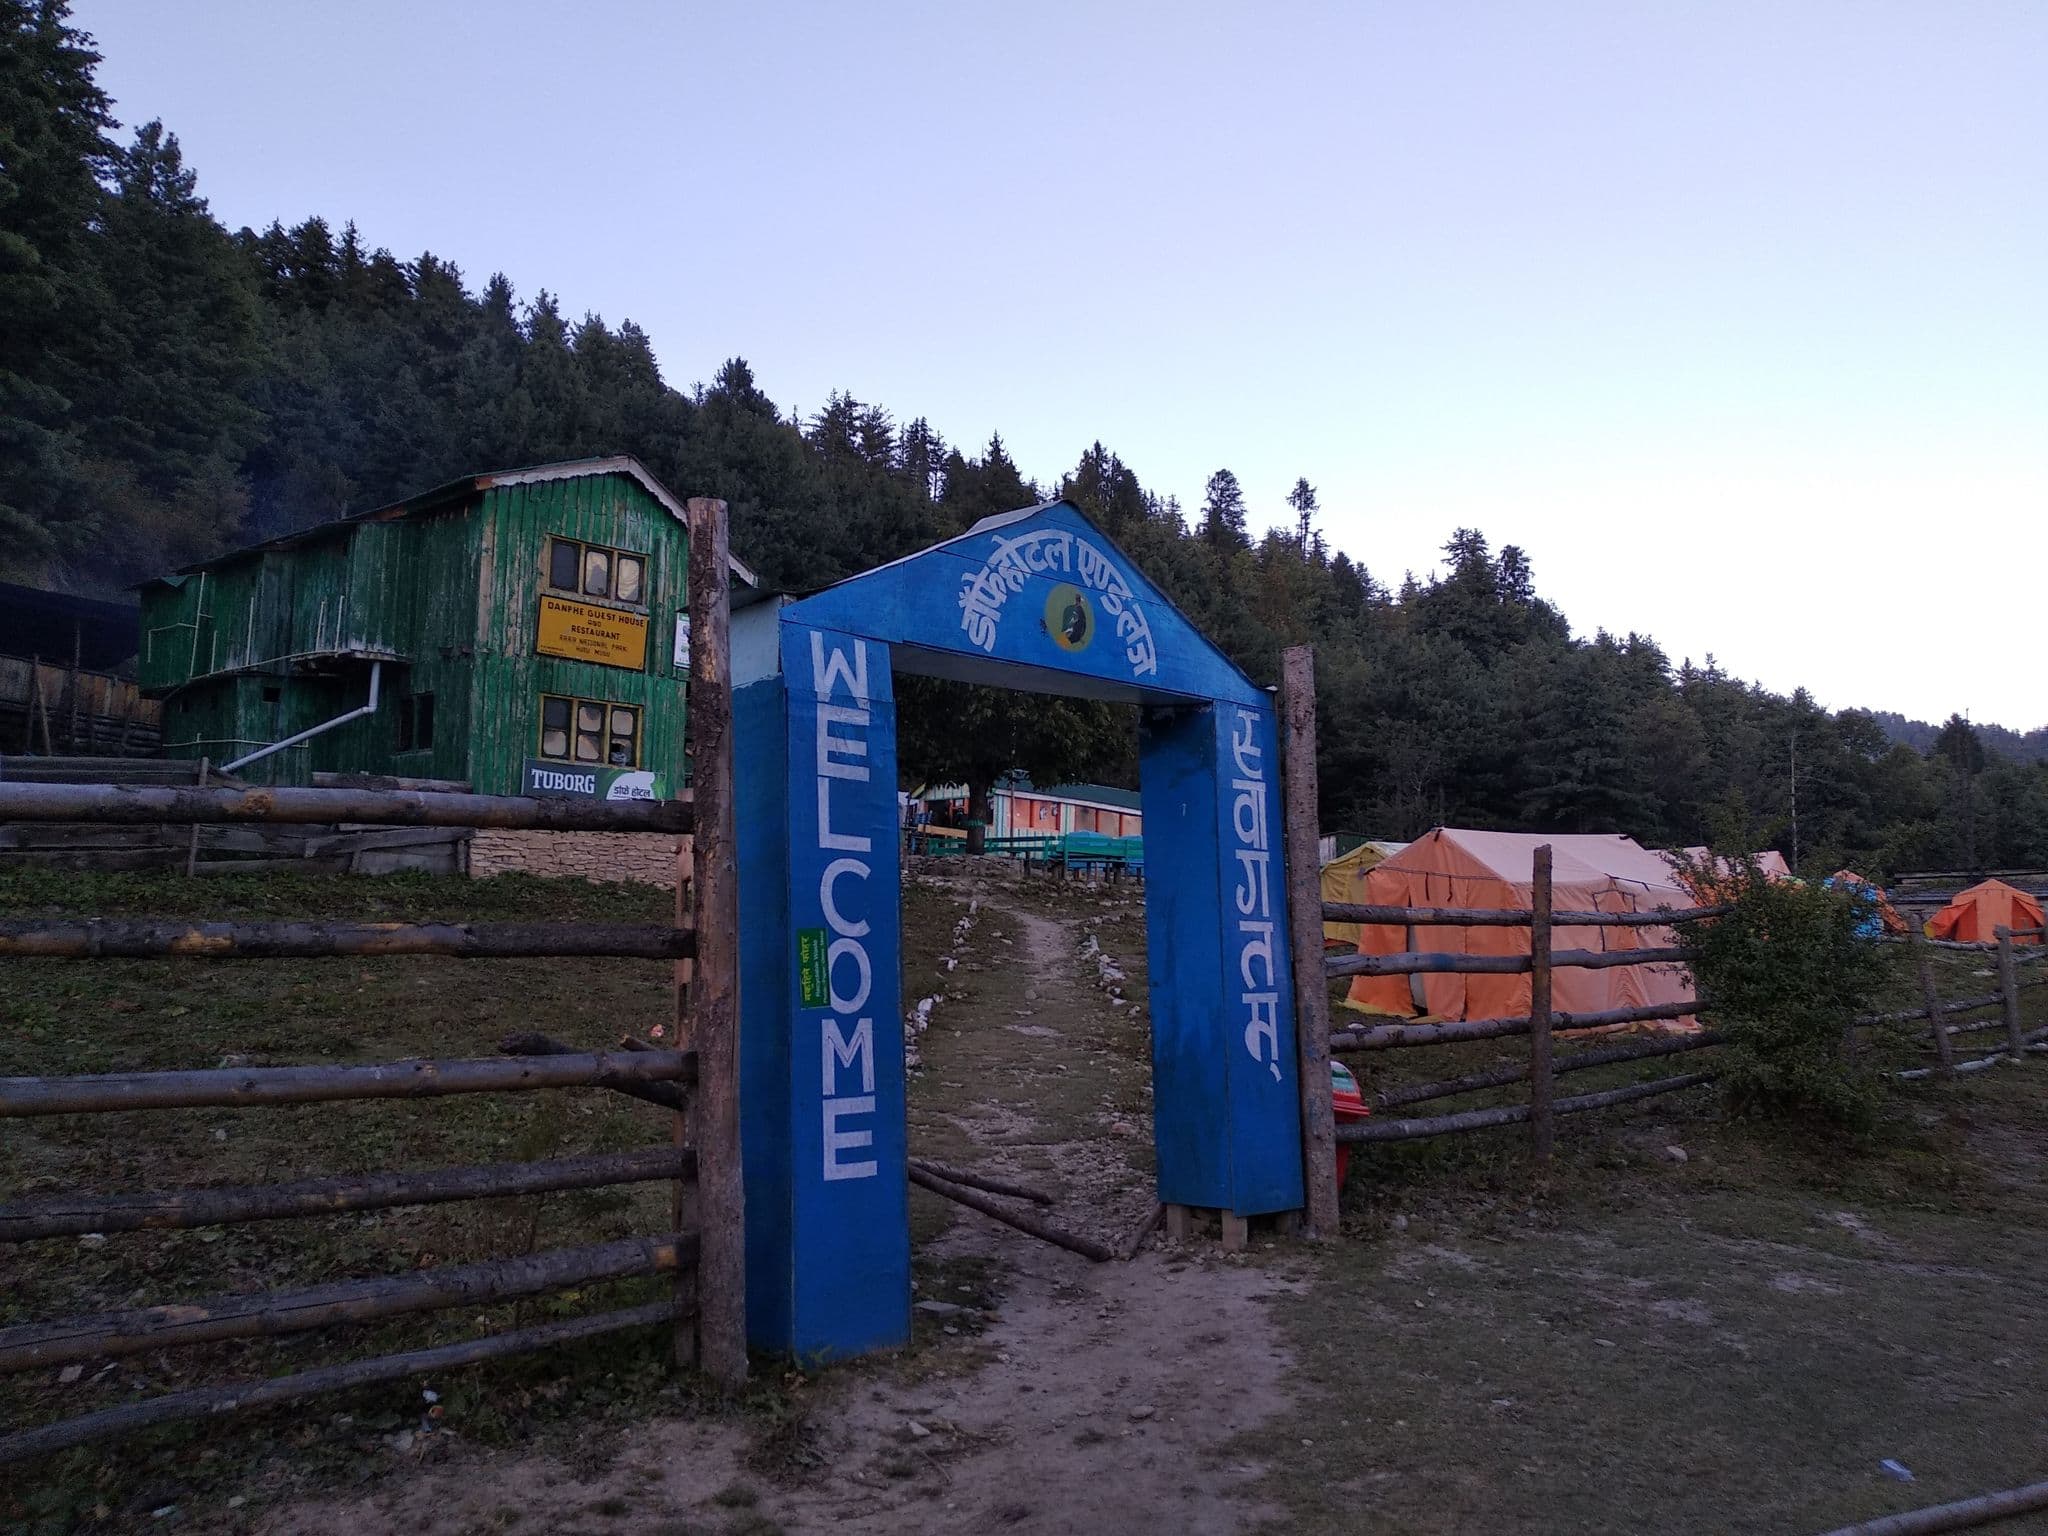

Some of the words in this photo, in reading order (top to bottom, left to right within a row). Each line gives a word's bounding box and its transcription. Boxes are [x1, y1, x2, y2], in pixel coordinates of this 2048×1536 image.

[548, 601, 584, 616] DANPHE
[587, 610, 616, 622] GUEST
[618, 615, 644, 627] HOUSE
[571, 625, 620, 640] RESTAURANT
[989, 528, 1075, 593] होटल
[1076, 537, 1134, 617] एण्ड
[1116, 603, 1157, 678] लज
[531, 768, 595, 794] TUBORG
[809, 629, 878, 1182] WELCOME
[1231, 708, 1283, 1083] स्वागतम्
